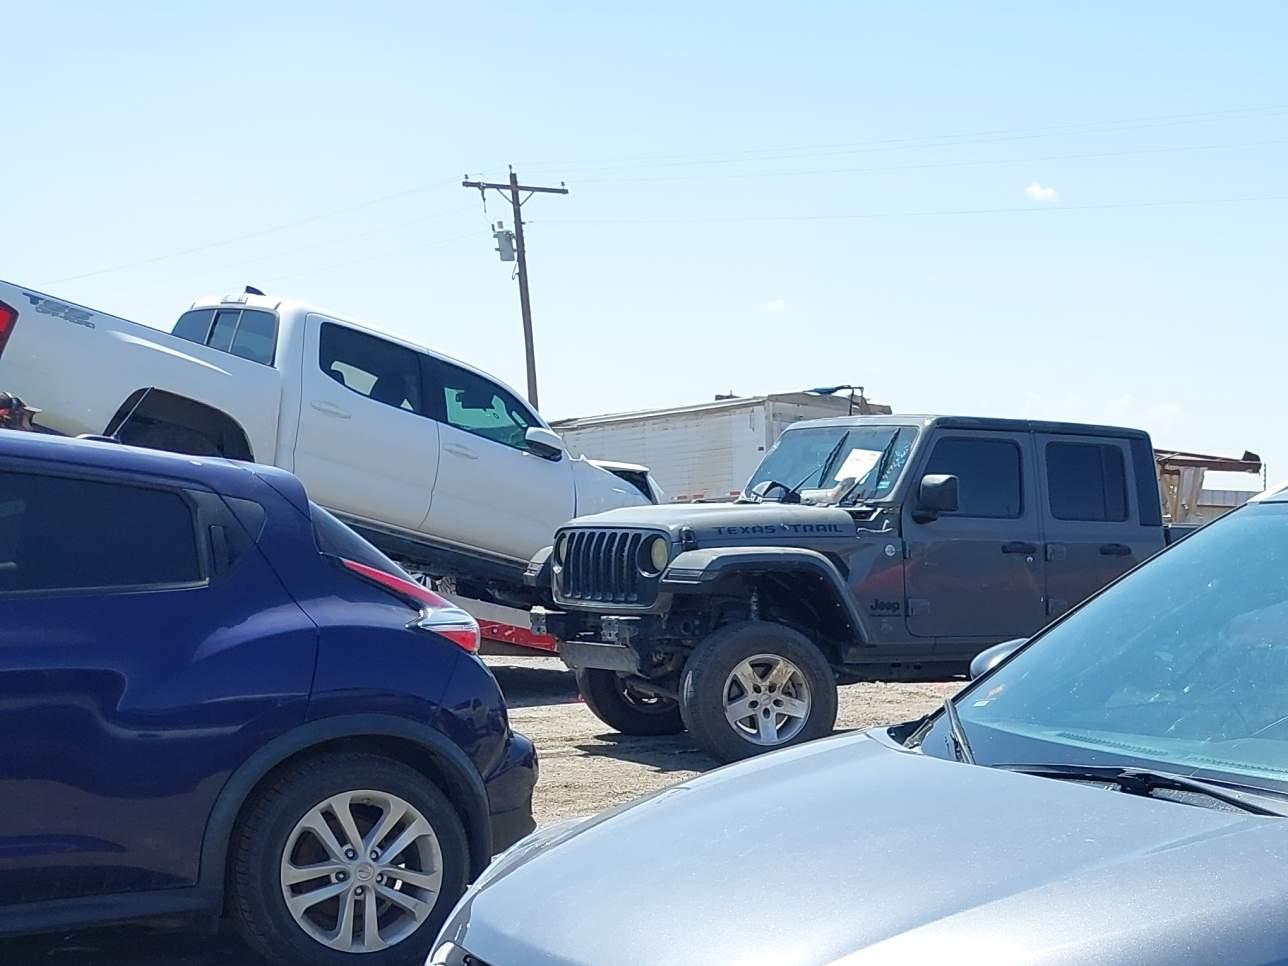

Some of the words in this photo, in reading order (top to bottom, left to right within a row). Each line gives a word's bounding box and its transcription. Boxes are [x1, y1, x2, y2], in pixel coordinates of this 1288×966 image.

[712, 525, 777, 535] TEXAS
[788, 524, 844, 533] TRAIL
[870, 599, 900, 613] Jeep
